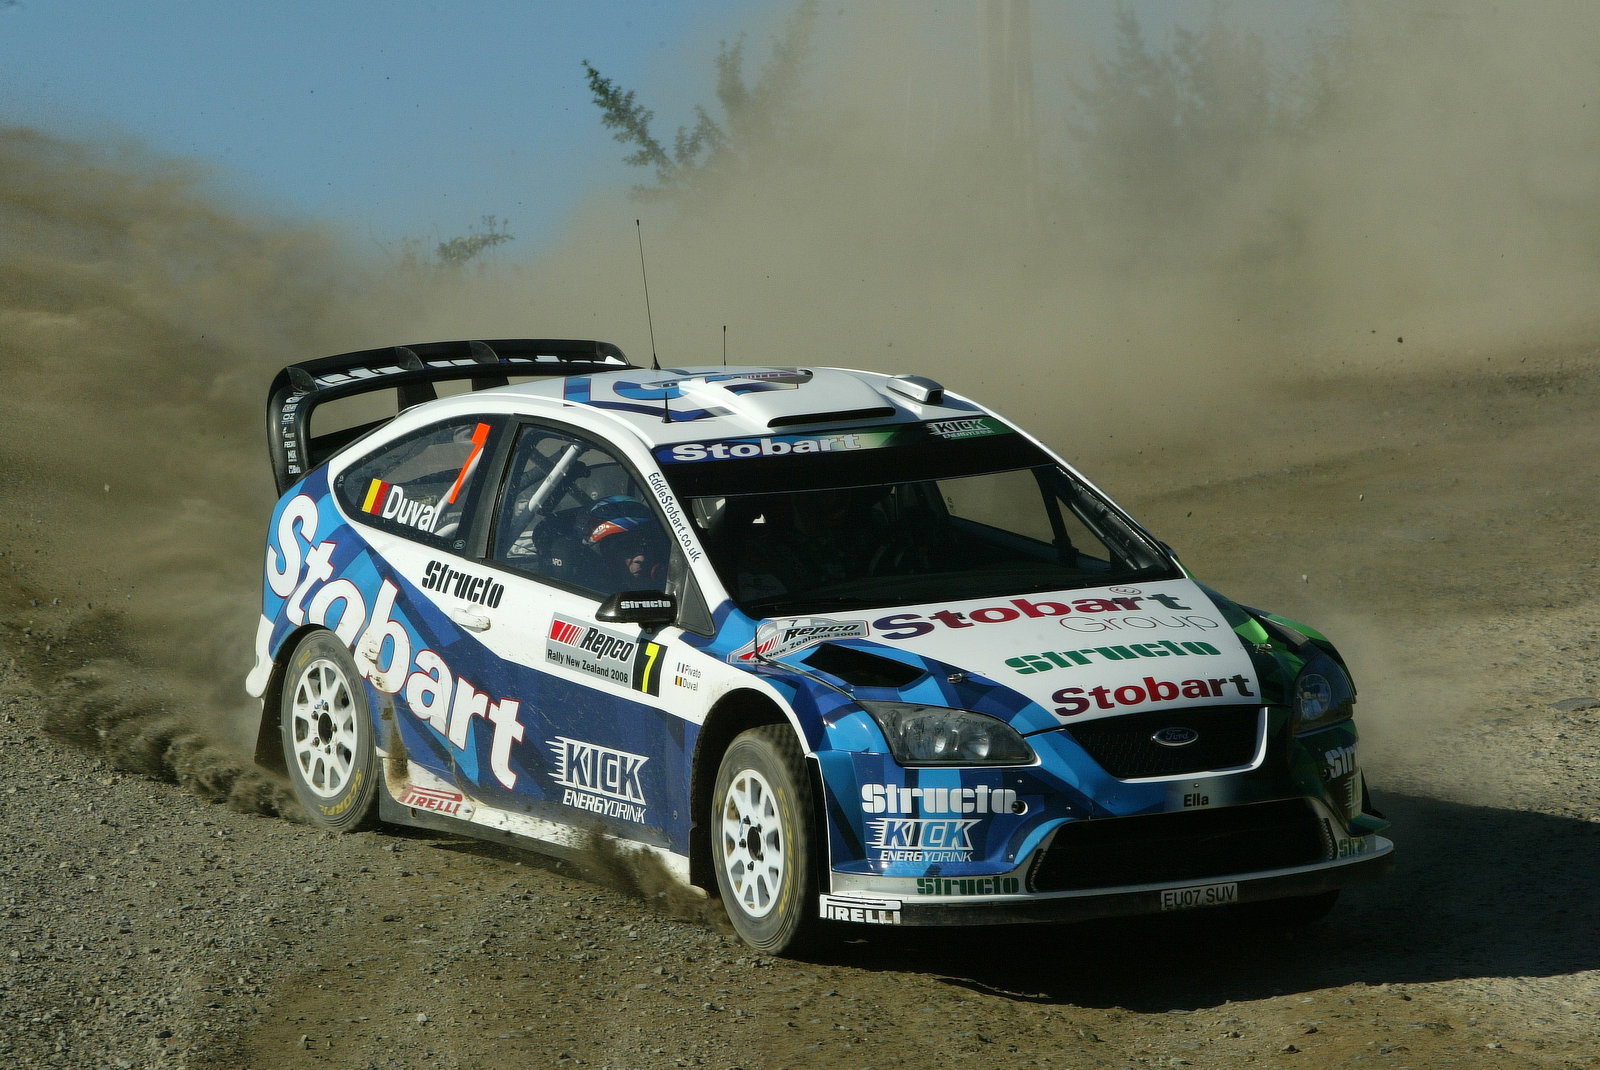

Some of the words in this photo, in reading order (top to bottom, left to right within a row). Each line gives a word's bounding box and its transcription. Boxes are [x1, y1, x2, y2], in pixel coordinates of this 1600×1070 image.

[928, 419, 991, 435] KICK
[672, 434, 861, 461] Stobart
[382, 485, 440, 533] Duval
[648, 472, 702, 563] EddieStobart.co.uk
[421, 560, 504, 608] Structo
[789, 620, 798, 628] 7
[872, 593, 1192, 640] Stobart
[1060, 615, 1219, 633] Group
[266, 494, 525, 790] Stobart
[580, 627, 635, 662] Repco
[765, 648, 787, 658] New
[790, 634, 831, 650] Zealand
[782, 624, 859, 644] Repco
[547, 649, 565, 665] Rally
[566, 653, 580, 668] New
[582, 658, 609, 678] Zealand
[611, 667, 628, 683] 2008
[641, 643, 660, 693] 7
[683, 678, 698, 692] Duval
[1052, 674, 1254, 717] Stobart
[1164, 729, 1190, 741] Ford
[558, 737, 649, 806] KICK
[400, 784, 463, 814] PIRELLI
[861, 783, 1018, 814] Structo
[1184, 793, 1209, 808] Ella
[876, 818, 982, 850] KICK
[917, 876, 1019, 895] Structo
[1164, 889, 1200, 908] EU07
[1206, 885, 1235, 904] SUV
[820, 894, 900, 924] PIRELLI
